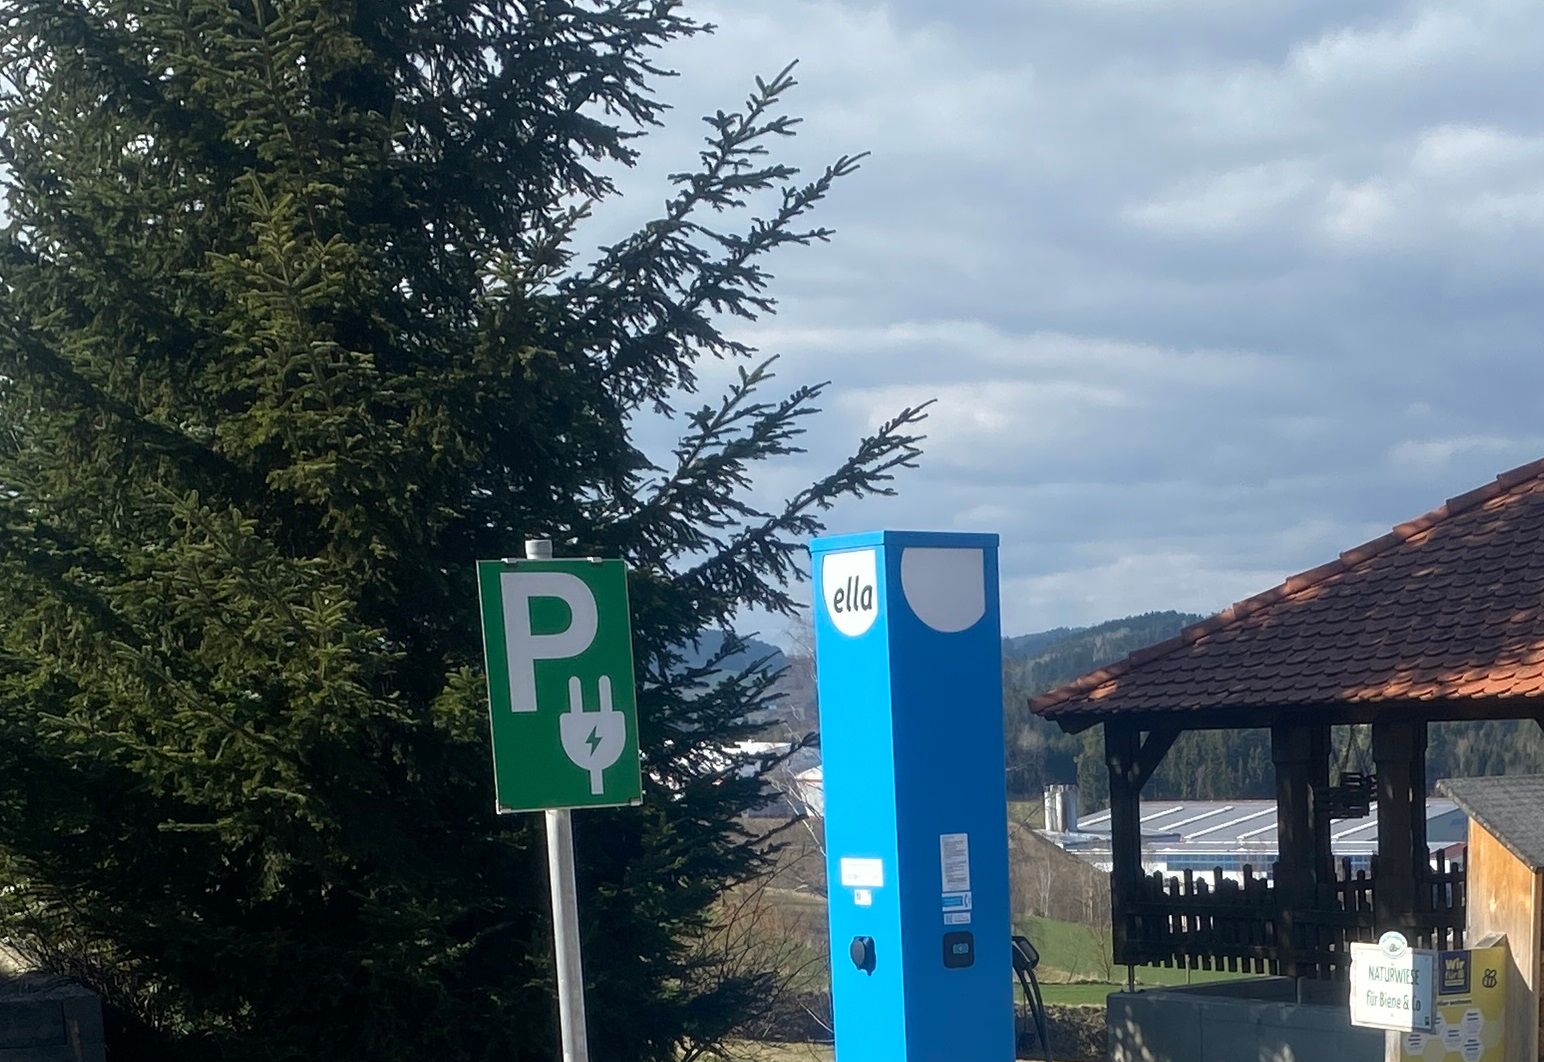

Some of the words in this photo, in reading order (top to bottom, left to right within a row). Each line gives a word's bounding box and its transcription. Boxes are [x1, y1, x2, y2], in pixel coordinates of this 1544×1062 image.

[833, 575, 873, 613] ella
[500, 572, 598, 712] P
[1445, 957, 1465, 970] Wir
[1368, 965, 1420, 986] NATURWIESE
[1366, 989, 1377, 1007] für
[1379, 991, 1401, 1010] Biene
[1402, 994, 1410, 1011] &
[1411, 995, 1422, 1012] Co
